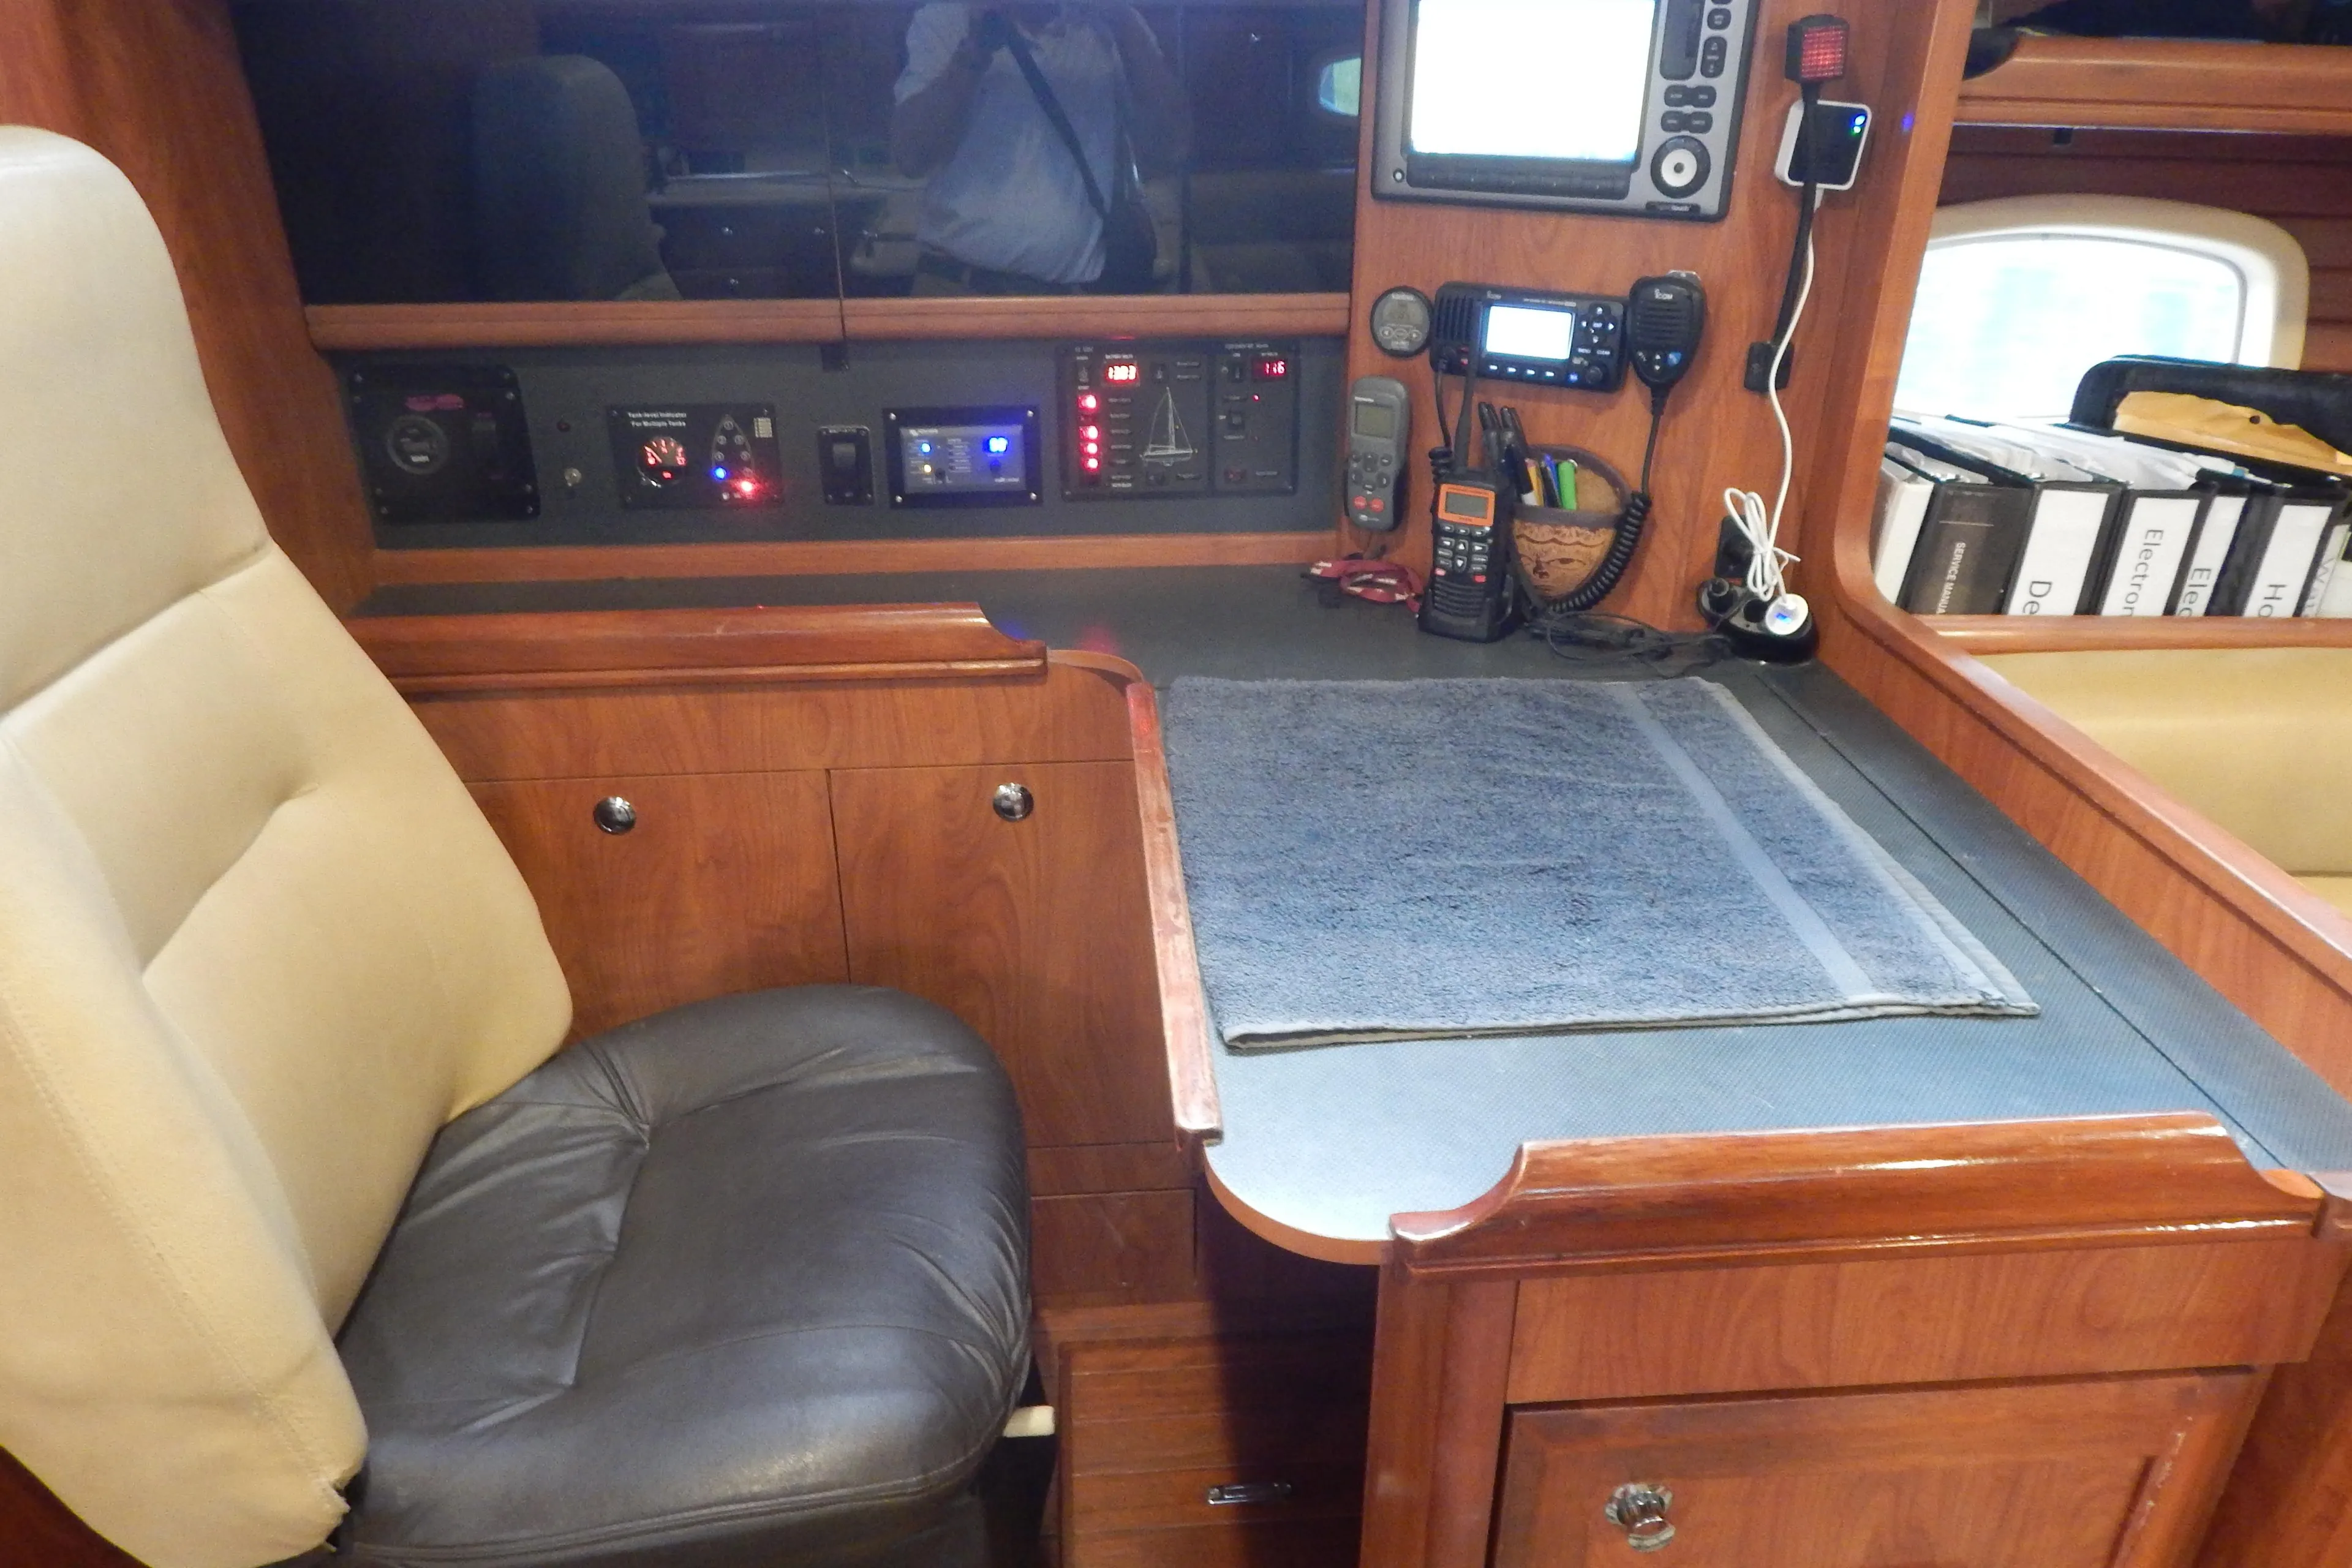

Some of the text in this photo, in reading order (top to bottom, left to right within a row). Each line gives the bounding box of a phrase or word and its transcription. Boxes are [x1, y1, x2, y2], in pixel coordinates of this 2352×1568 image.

[1945, 542, 1966, 581] SERVICE
[2023, 581, 2052, 614] De
[2258, 584, 2288, 617] Ho
